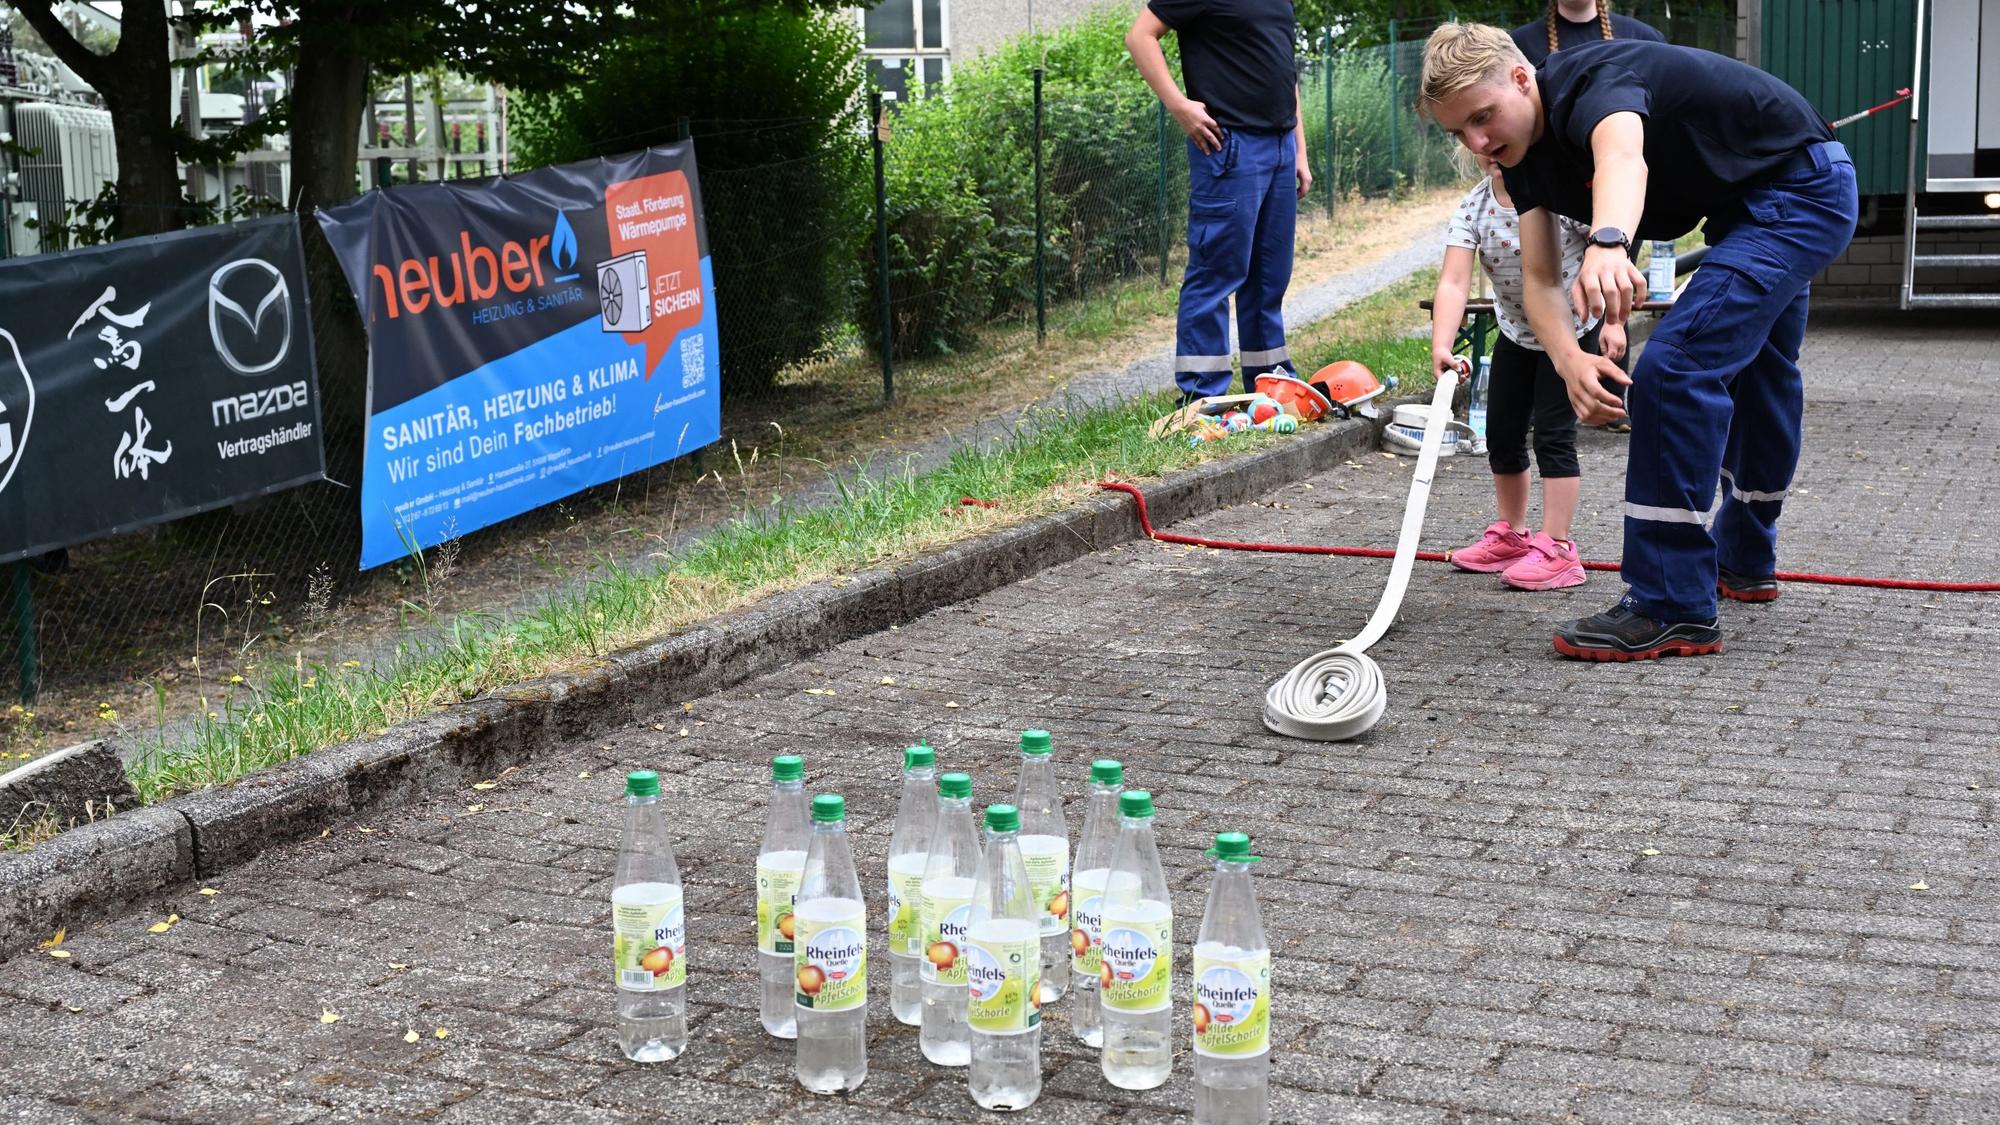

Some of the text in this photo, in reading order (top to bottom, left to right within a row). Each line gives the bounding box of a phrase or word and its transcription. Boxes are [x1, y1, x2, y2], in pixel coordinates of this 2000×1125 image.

[616, 194, 685, 219] Staatl. Förderung
[618, 212, 687, 240] Wärmepumpe
[373, 231, 550, 322] neuber
[653, 271, 682, 295] JETZT
[472, 287, 585, 325] HEIZUNG & SANITÄR
[654, 288, 701, 317] SICHERN
[383, 358, 639, 451] SANITÄR, HEIZUNG & KLIMA
[217, 421, 312, 459] Vertragshändler
[387, 457, 419, 484] Wir
[425, 443, 464, 473] sind
[469, 431, 508, 459] Dein
[514, 394, 617, 445] Fachbetrieb!
[806, 943, 863, 959] Rheinfels
[1102, 942, 1158, 960] Rheinfels
[1196, 982, 1258, 1001] Rheinfels
[1201, 1026, 1262, 1047] ApfelSchorle
